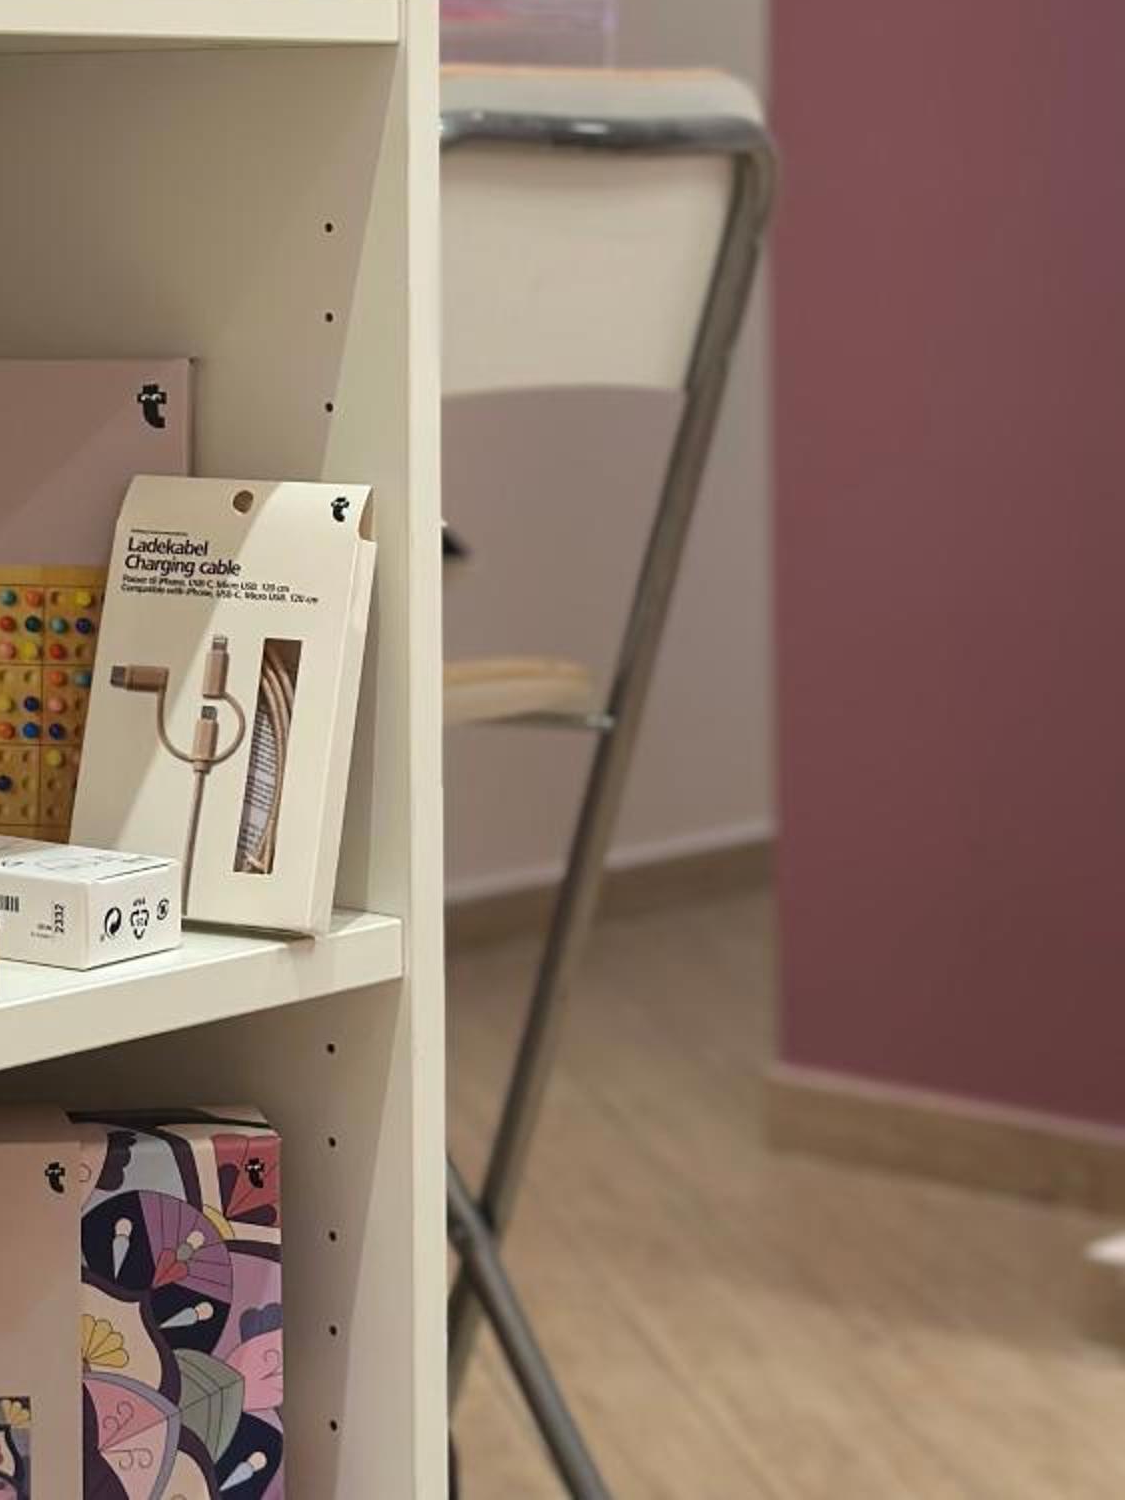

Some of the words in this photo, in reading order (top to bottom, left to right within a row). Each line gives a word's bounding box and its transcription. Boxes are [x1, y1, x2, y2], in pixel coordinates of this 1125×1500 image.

[127, 536, 209, 557] Ladekabel
[125, 554, 196, 578] Charging
[198, 559, 242, 577] cable
